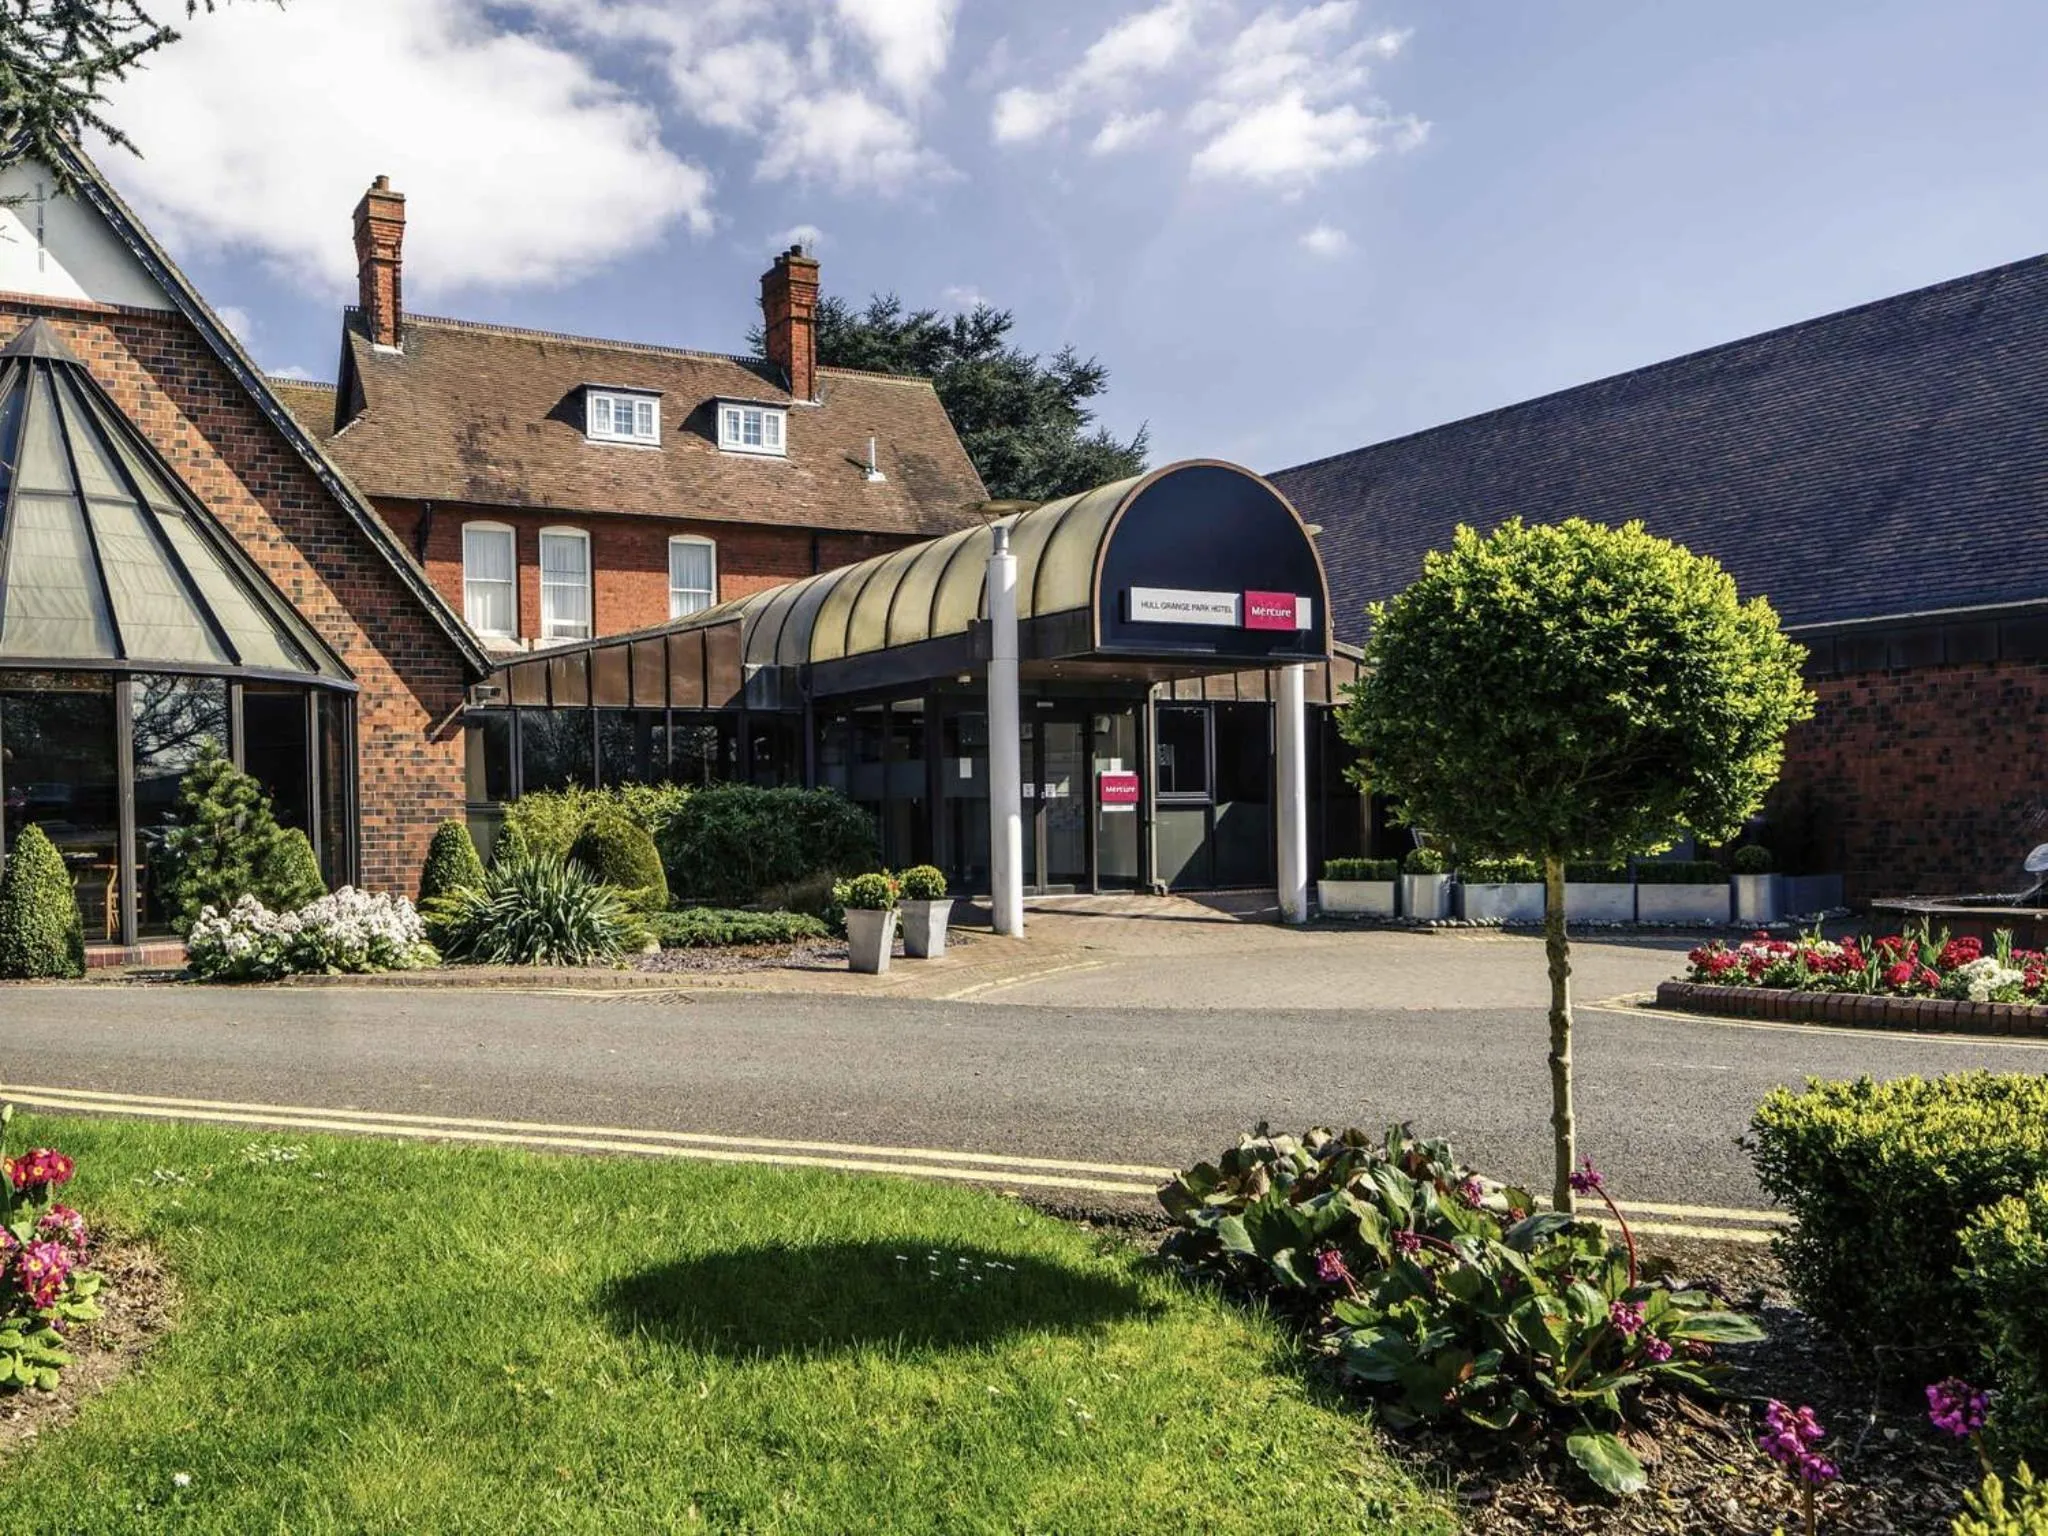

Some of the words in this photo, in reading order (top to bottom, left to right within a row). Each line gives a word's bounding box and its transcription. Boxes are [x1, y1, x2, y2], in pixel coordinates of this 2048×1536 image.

[1141, 601, 1160, 610] HULL
[1160, 602, 1190, 611] GRANGE
[1192, 603, 1209, 613] PARK
[1211, 605, 1233, 614] HOTEL
[1251, 606, 1292, 617] Mercure
